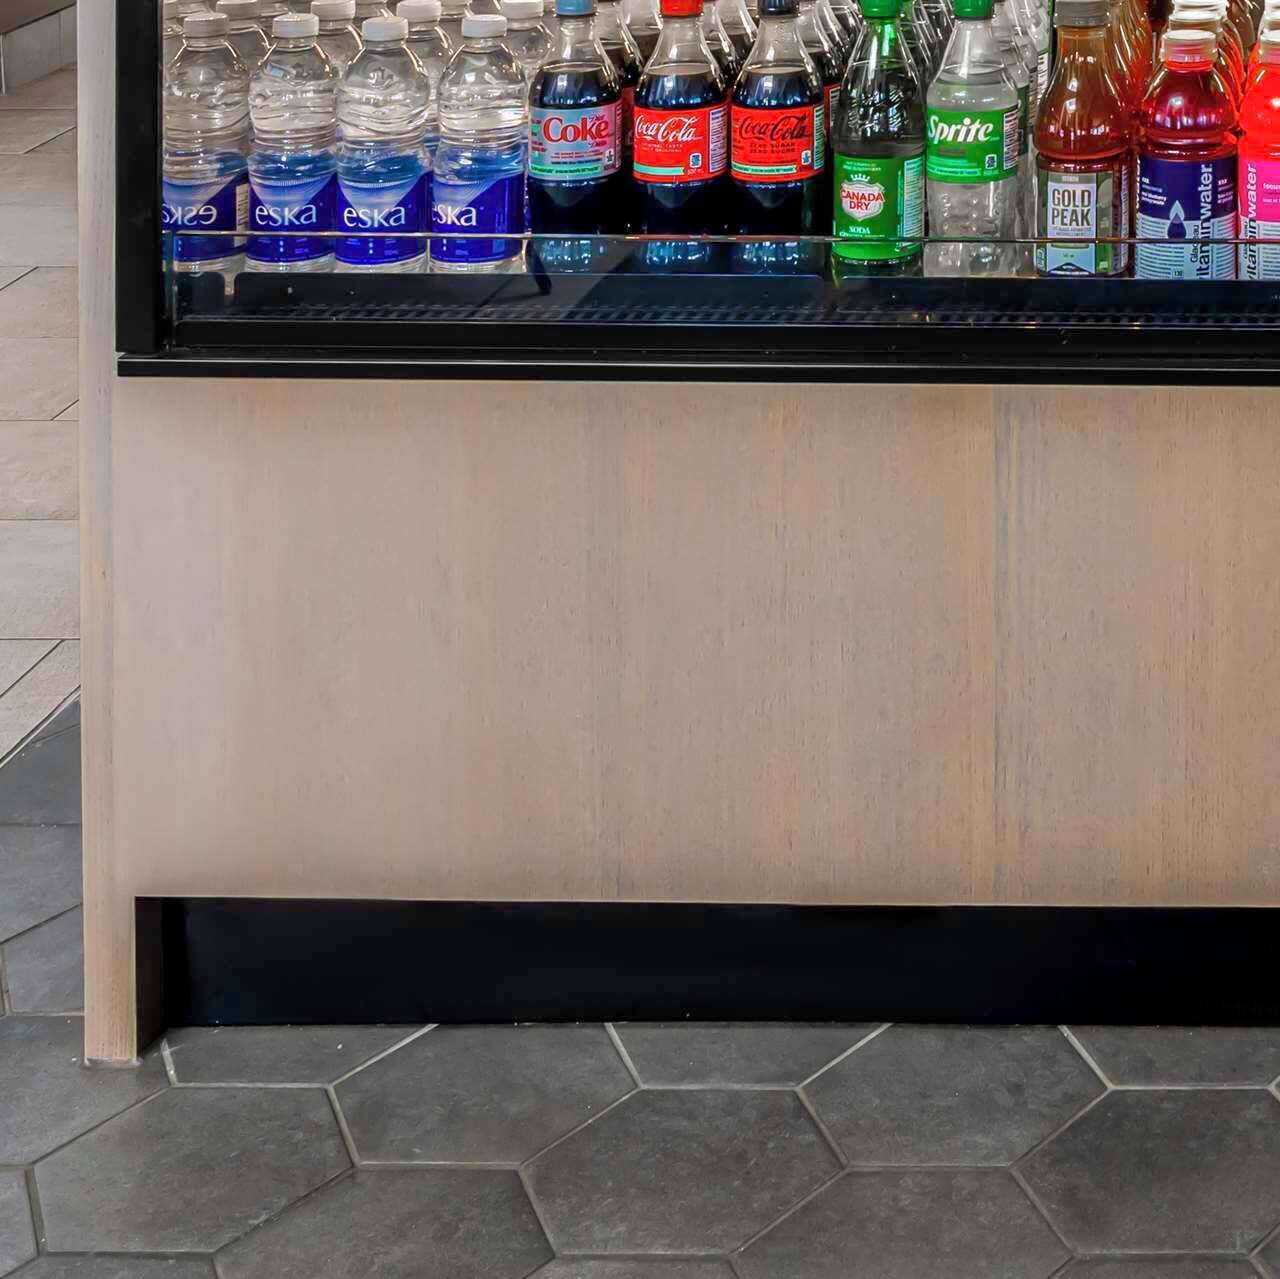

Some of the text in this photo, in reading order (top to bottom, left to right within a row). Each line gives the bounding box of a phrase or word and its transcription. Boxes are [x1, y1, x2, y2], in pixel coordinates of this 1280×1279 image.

[543, 117, 612, 144] Coke
[635, 115, 704, 141] Coca-Cola
[739, 115, 812, 142] Coca-Cola
[928, 117, 994, 144] Sprite
[840, 190, 885, 204] CANADA
[849, 201, 871, 212] DRY
[1051, 188, 1091, 207] GOLD
[255, 204, 317, 228] eska
[343, 205, 406, 229] eska
[1051, 207, 1091, 227] PEAK
